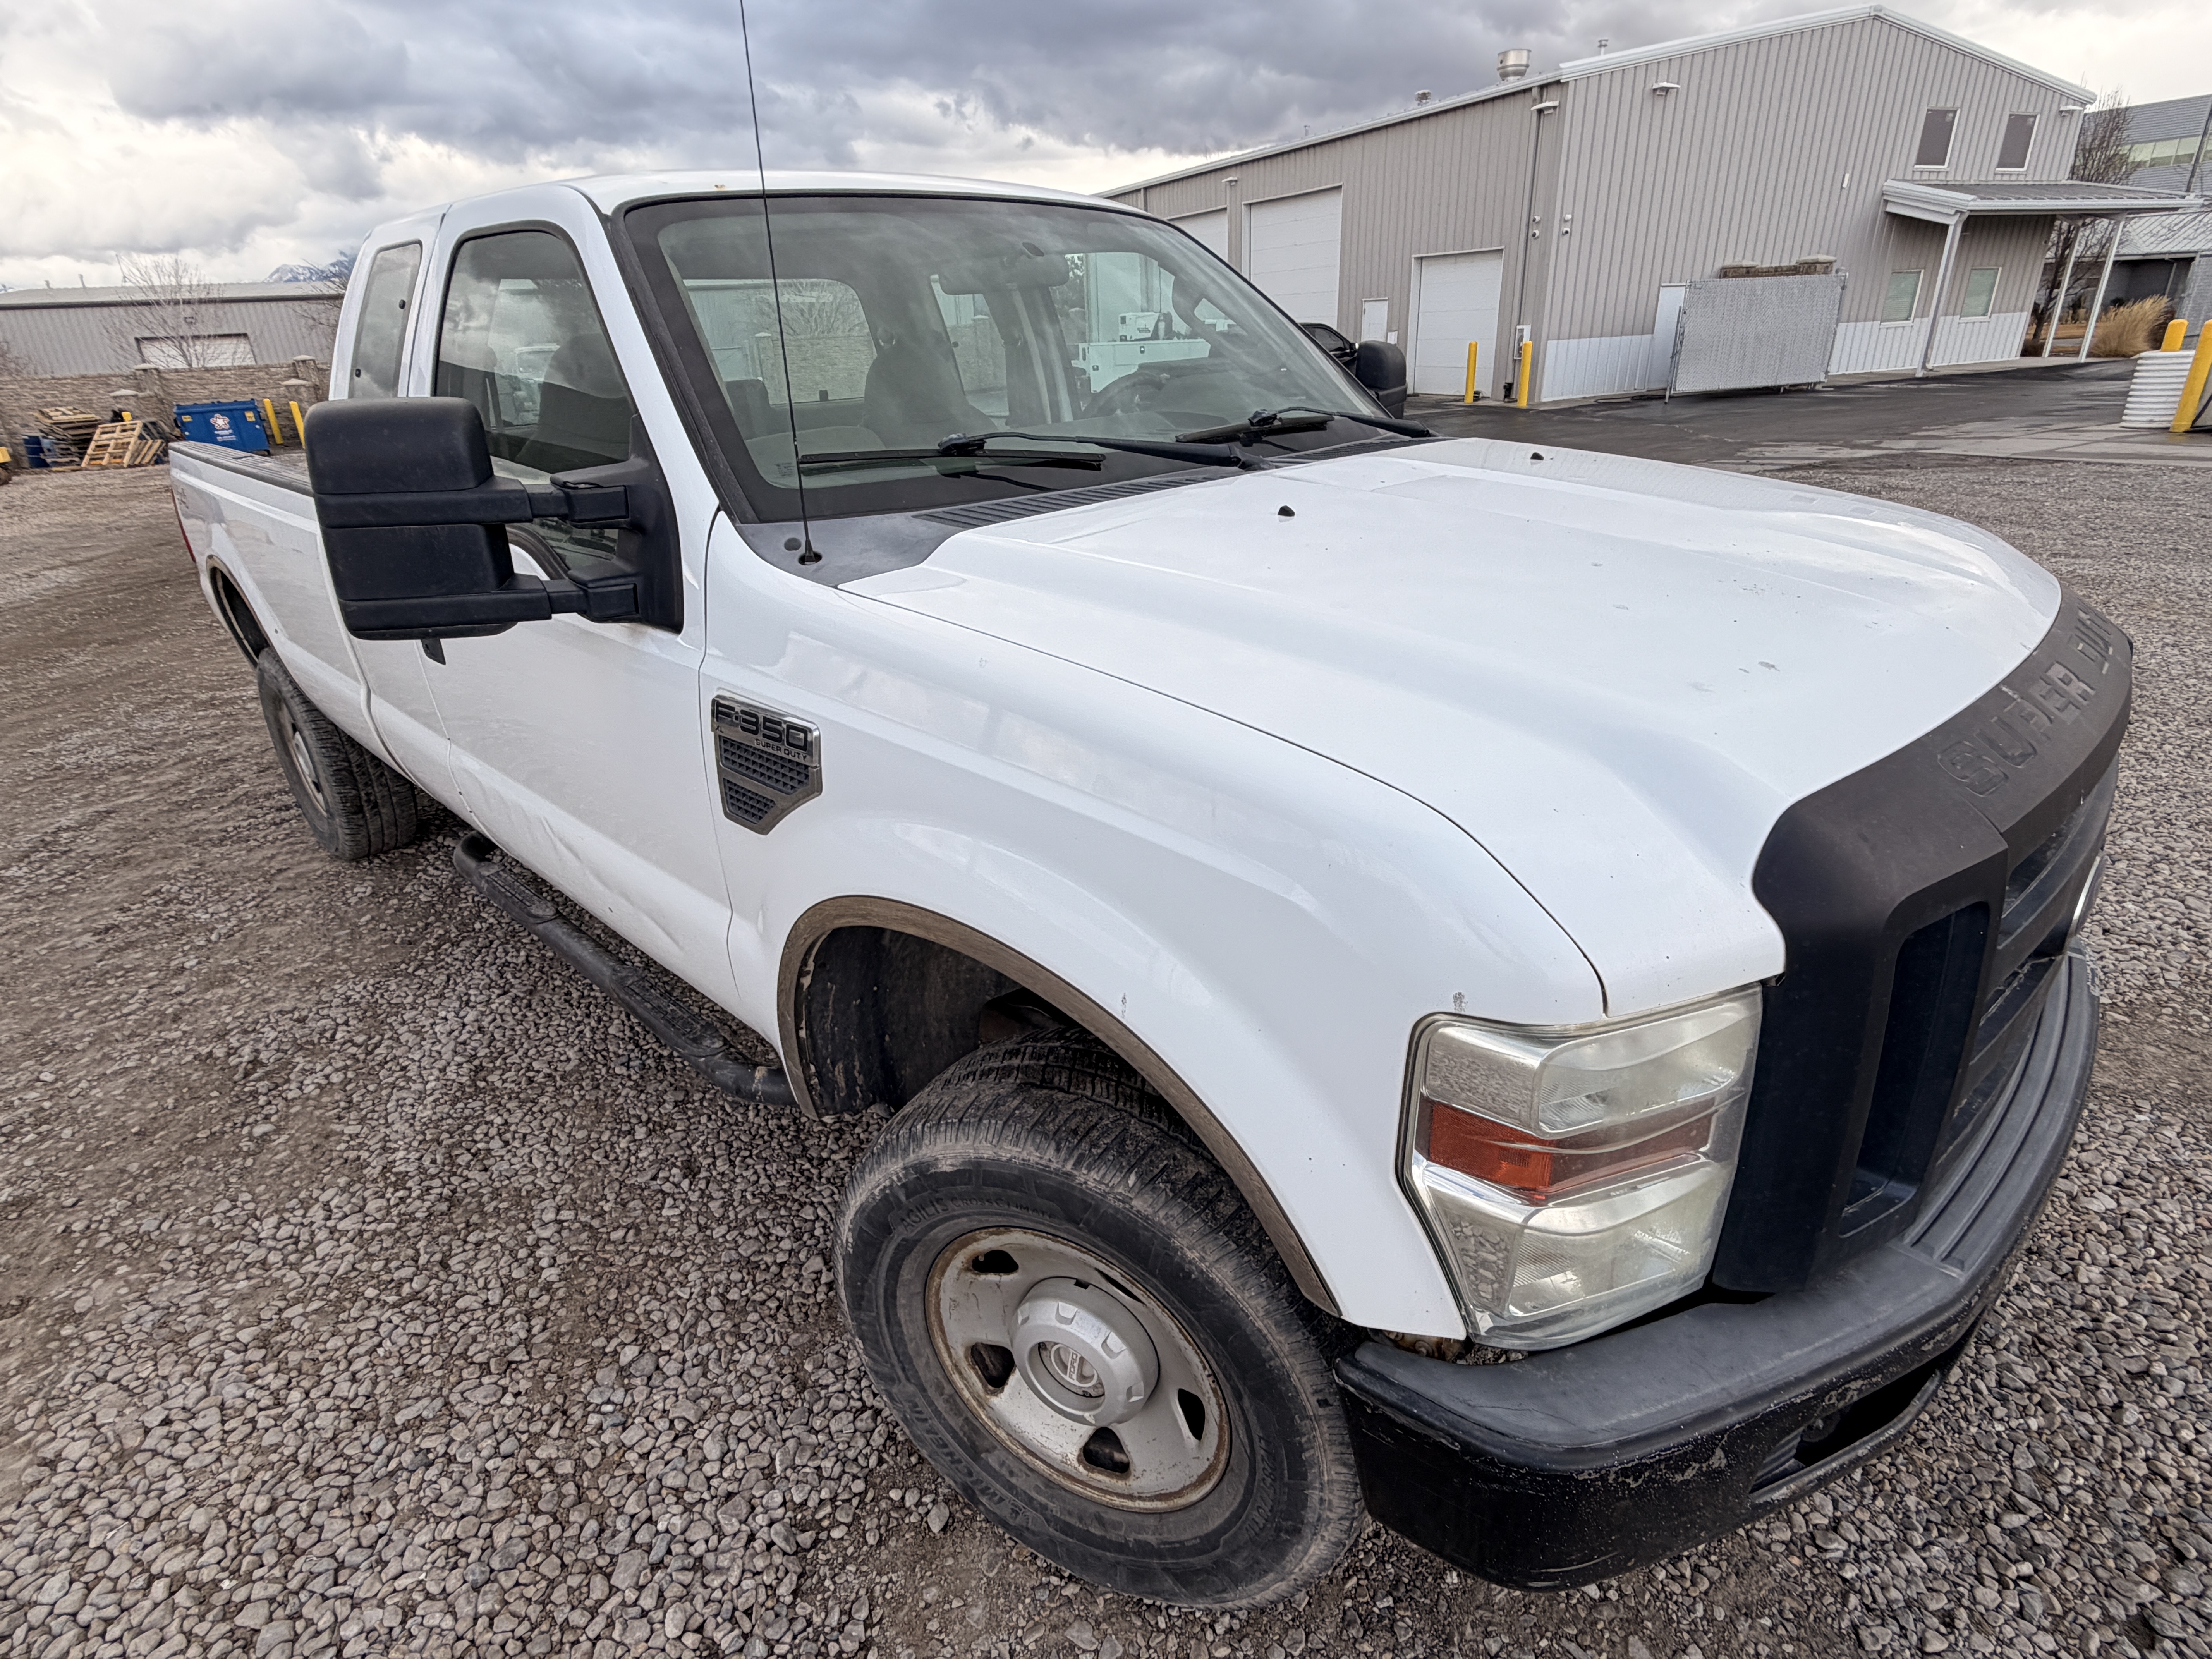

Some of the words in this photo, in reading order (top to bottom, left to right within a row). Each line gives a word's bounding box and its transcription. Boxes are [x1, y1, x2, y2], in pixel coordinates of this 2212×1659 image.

[715, 700, 809, 752] F-350
[1937, 661, 2095, 797] SUPER
[756, 738, 781, 753] SUPER
[784, 748, 807, 761] DUTY
[900, 1197, 949, 1232] AGILIS
[1068, 1352, 1078, 1381] FORD
